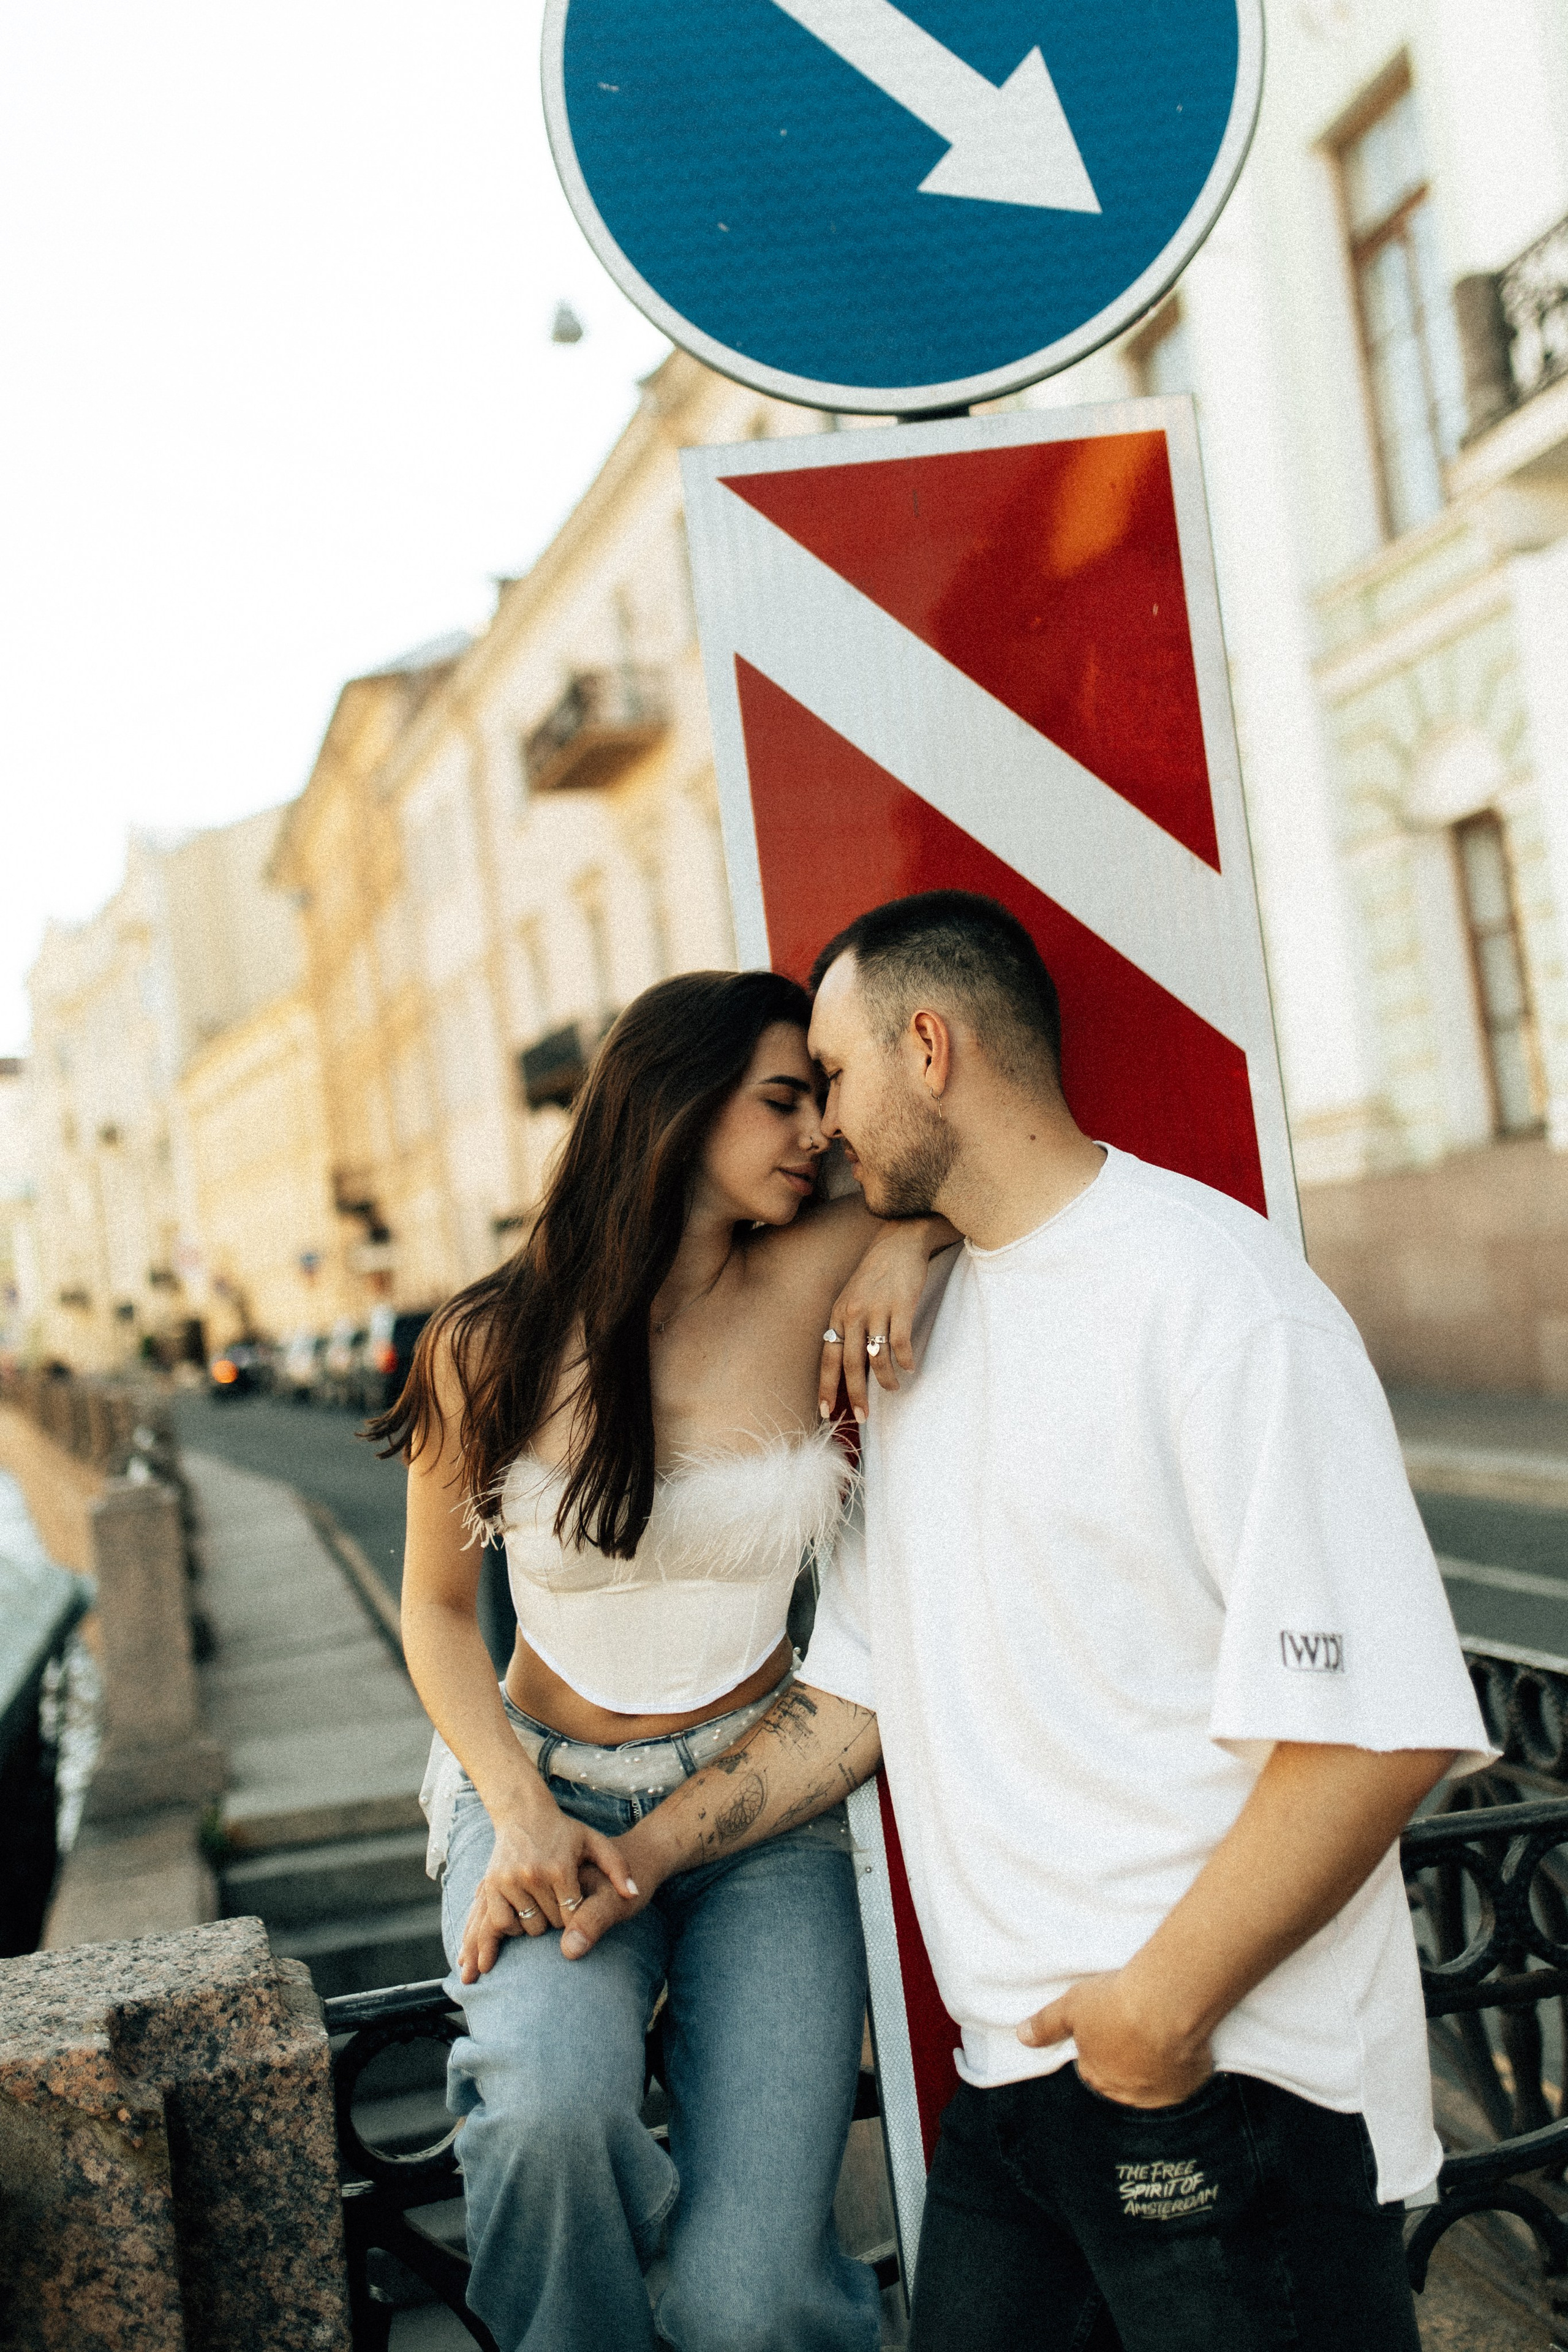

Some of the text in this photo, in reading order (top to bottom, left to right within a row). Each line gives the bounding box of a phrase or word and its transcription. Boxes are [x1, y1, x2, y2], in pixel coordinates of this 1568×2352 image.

[1115, 2160, 1197, 2182] THE FREE
[1119, 2171, 1204, 2200] SPIRIT OF
[1124, 2184, 1219, 2217] AMSTERDAM
